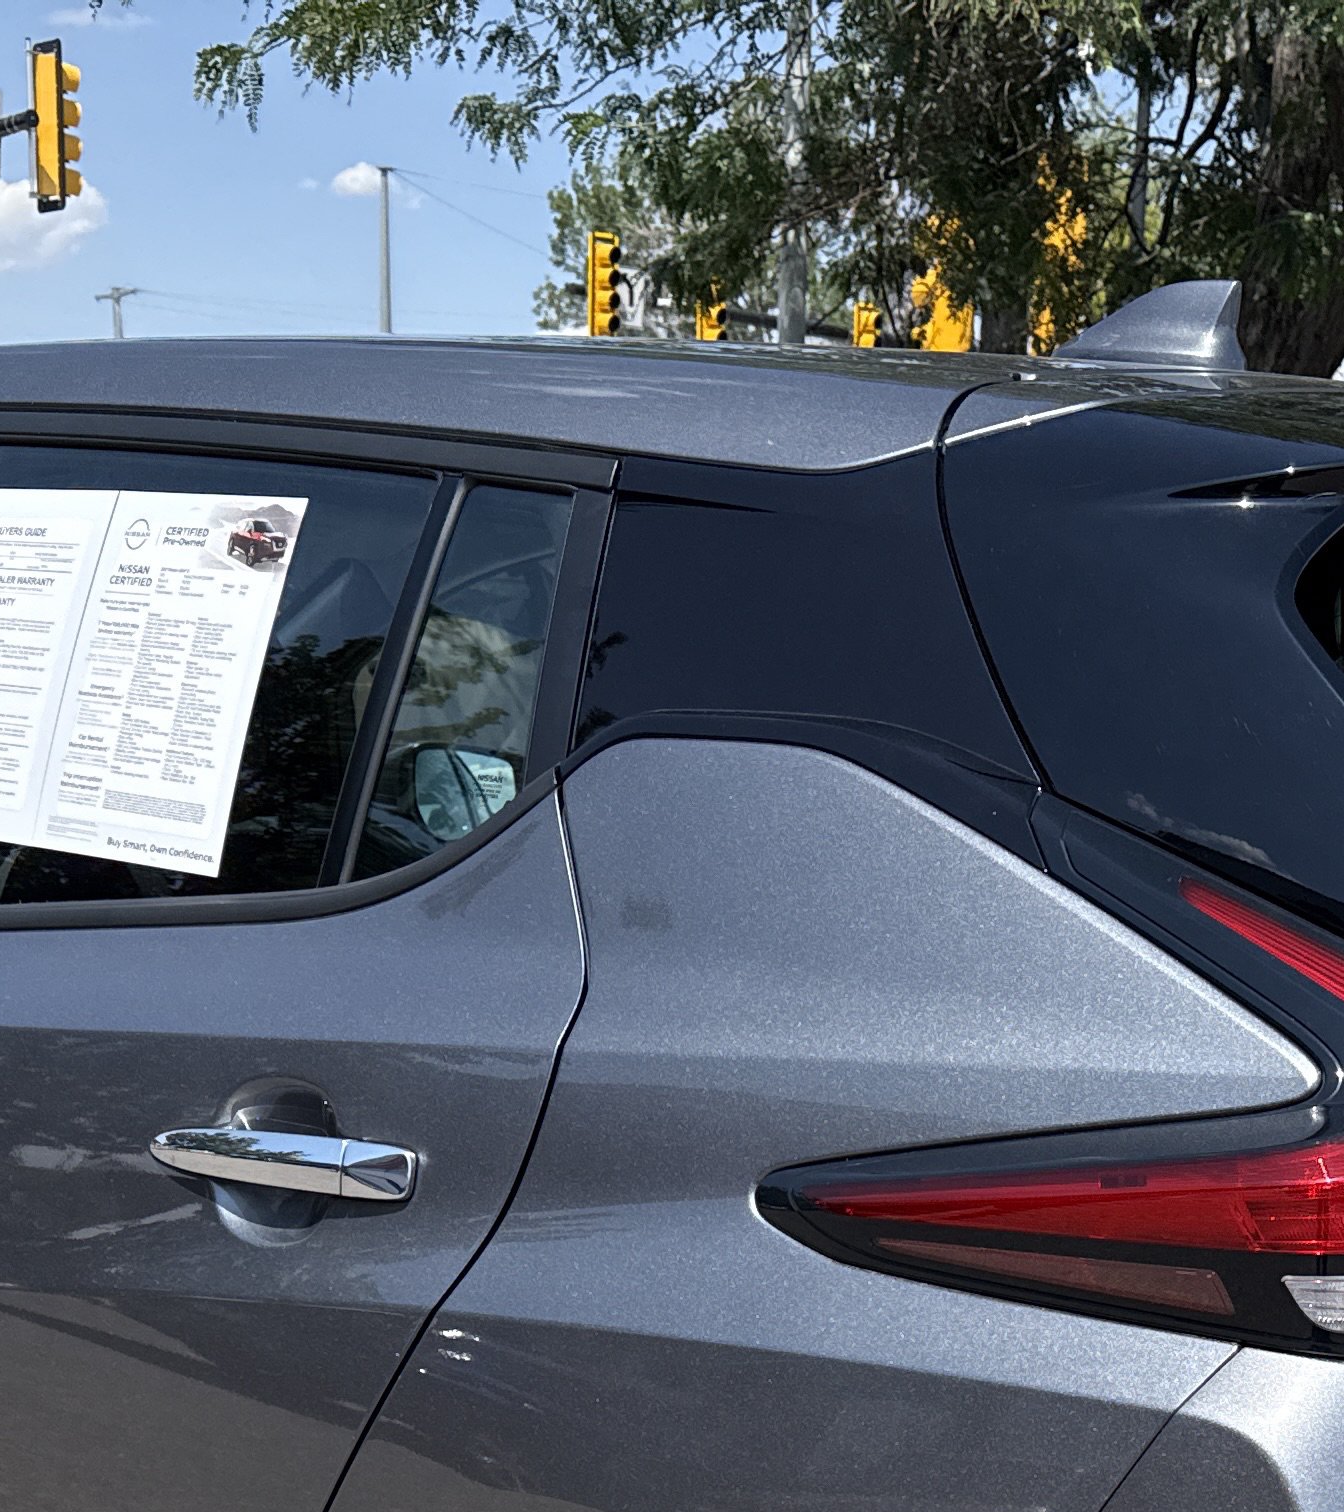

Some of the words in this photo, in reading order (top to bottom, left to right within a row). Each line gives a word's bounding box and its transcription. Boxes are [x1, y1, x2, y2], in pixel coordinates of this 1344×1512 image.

[24, 527, 48, 537] GUIDE
[165, 526, 210, 537] CERTIFIED
[162, 537, 207, 548] Pre-Owned
[117, 563, 151, 575] NISSAN
[109, 575, 153, 587] CERTIFIED
[106, 836, 121, 848] Buy
[149, 844, 168, 856] Own
